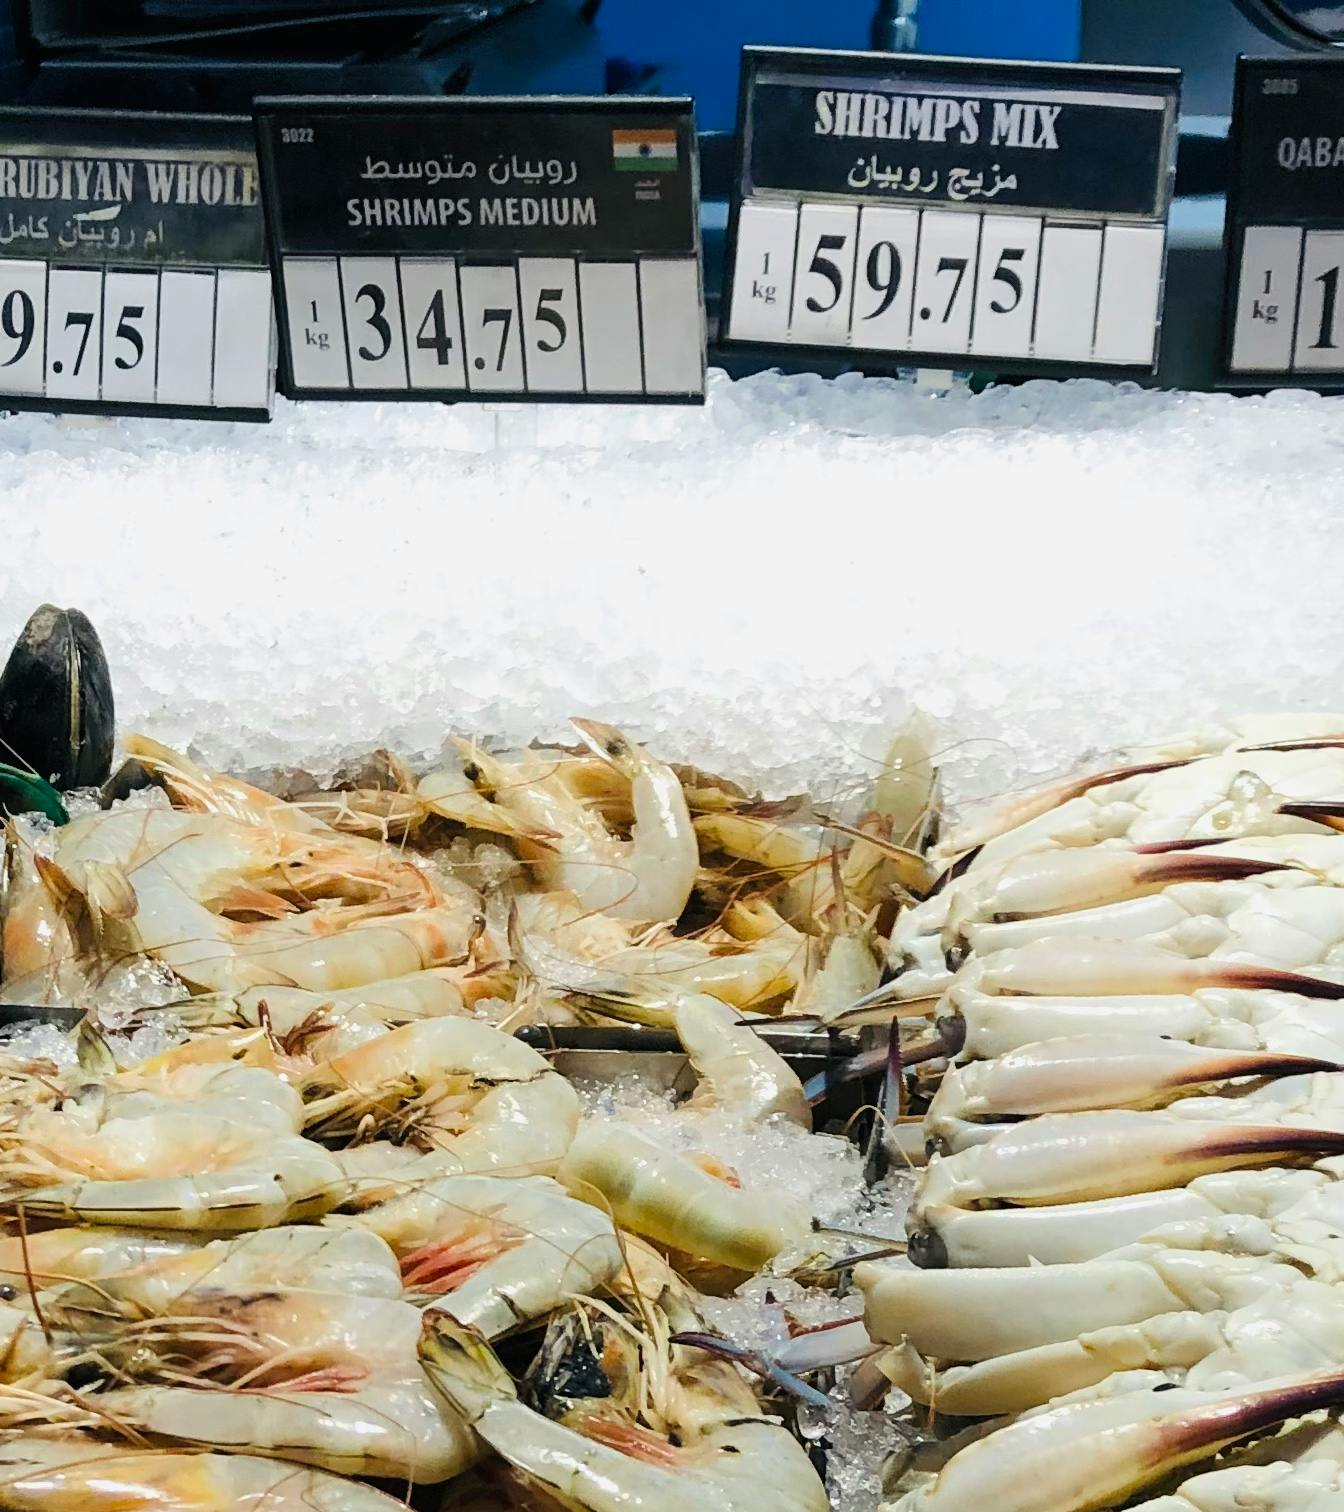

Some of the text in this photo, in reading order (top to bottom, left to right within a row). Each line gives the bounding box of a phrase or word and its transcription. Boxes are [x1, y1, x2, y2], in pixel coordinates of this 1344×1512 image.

[814, 90, 1063, 150] SHRIMPS MIX
[145, 162, 258, 206] WHOLE
[360, 153, 579, 186] روبيان متوسط
[846, 154, 1019, 200] مزيج روبيان
[346, 197, 597, 227] SHRIMPS MEDIUM
[751, 281, 777, 304] kg
[805, 233, 1027, 324] 59.75
[354, 283, 568, 372] 34.75
[1252, 300, 1279, 323] kg
[304, 328, 331, 351] kg
